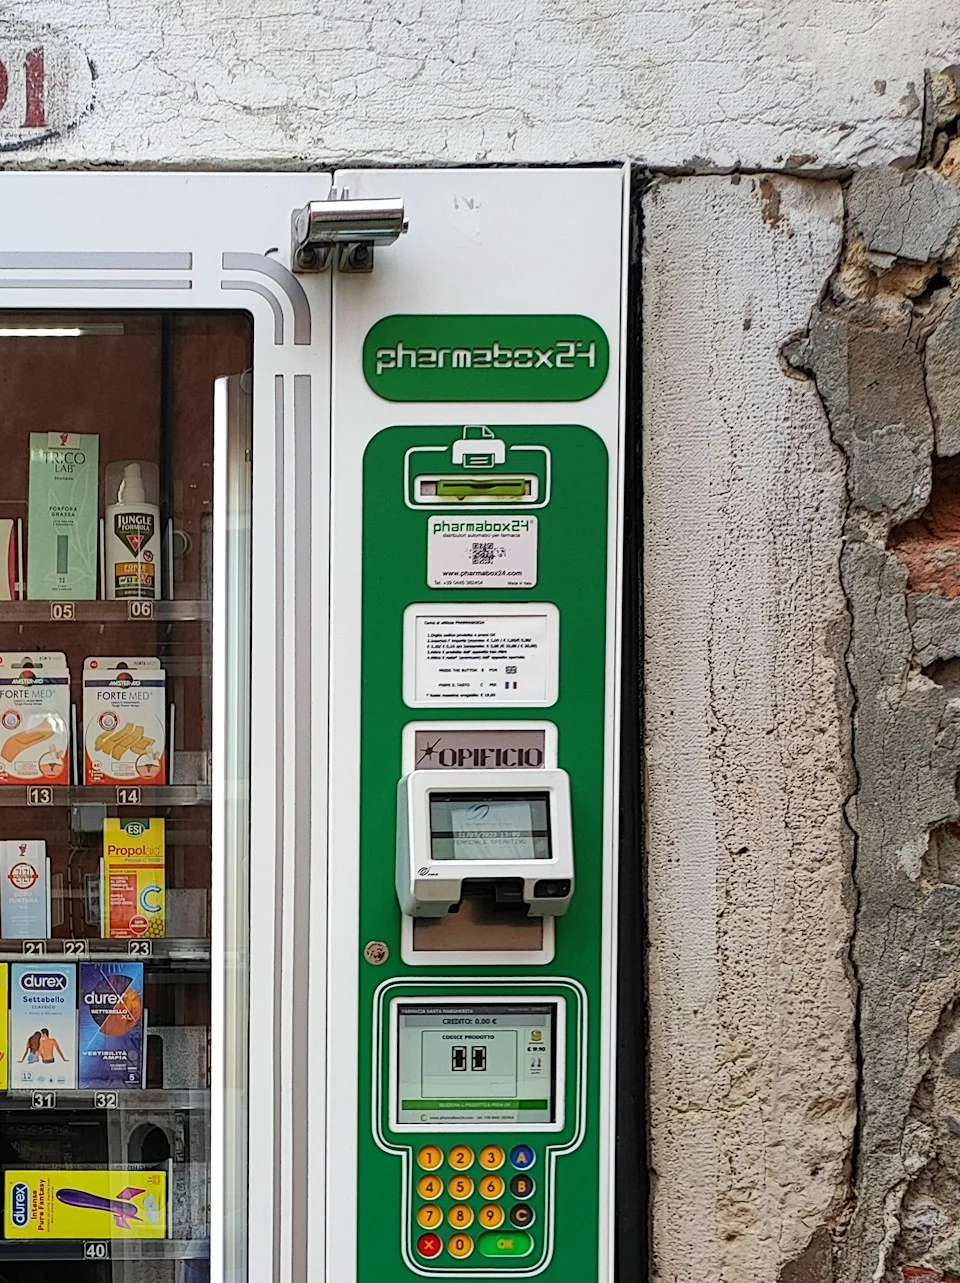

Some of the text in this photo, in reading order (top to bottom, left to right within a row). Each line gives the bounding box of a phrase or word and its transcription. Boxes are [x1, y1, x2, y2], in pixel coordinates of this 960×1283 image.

[376, 341, 597, 375] pharmabox24
[43, 451, 86, 465] TRICO
[54, 464, 74, 473] LAB
[118, 514, 152, 528] JUNGLE
[121, 523, 151, 532] FORMULA
[433, 519, 530, 535] pharmabox24
[442, 569, 522, 577] www.pharmabox24.com
[53, 604, 73, 619] 05
[131, 602, 150, 617] 06
[0, 689, 53, 699] FORTE MED
[96, 691, 150, 701] FORTE MED
[438, 747, 543, 768] OPIFICIO
[126, 823, 143, 835] ESI
[22, 973, 65, 989] durex
[22, 995, 65, 1004] Settebello
[84, 991, 125, 1005] durex
[34, 1093, 53, 1107] 31
[97, 1092, 116, 1107] 32
[427, 1151, 528, 1164] 1 2 3 A
[425, 1181, 527, 1193] 4 5 6 B
[13, 1185, 27, 1224] durex
[31, 1188, 39, 1221] Intense
[37, 1178, 47, 1232] Pure Fantasy
[426, 1209, 528, 1222] 7 8 9 C
[456, 1239, 464, 1250] 0
[497, 1239, 514, 1250] OK
